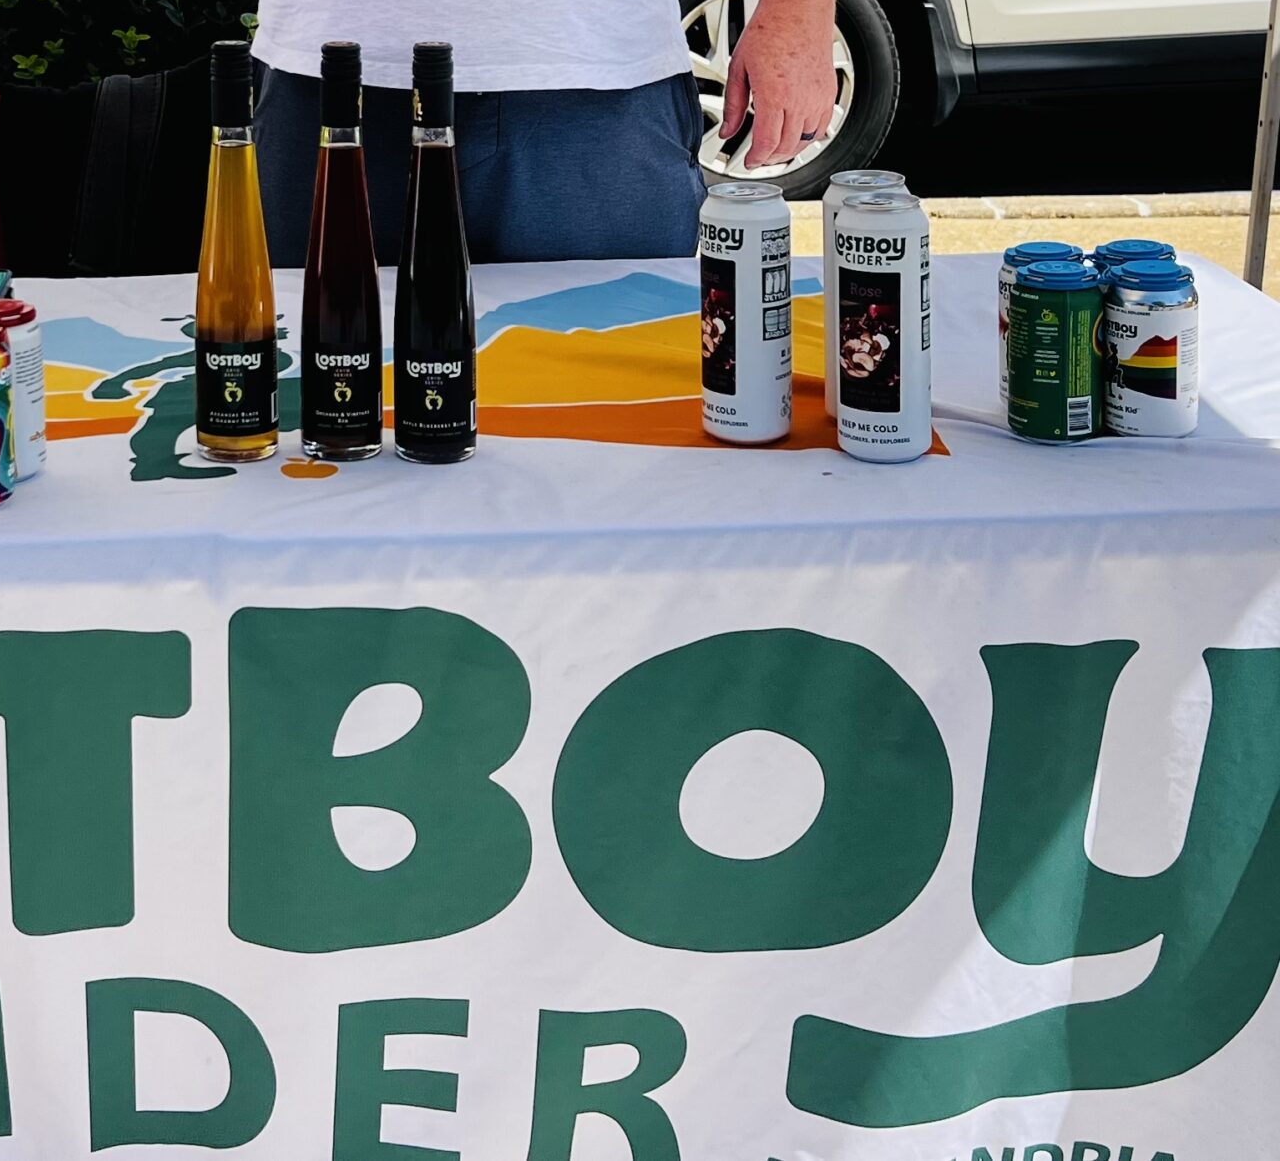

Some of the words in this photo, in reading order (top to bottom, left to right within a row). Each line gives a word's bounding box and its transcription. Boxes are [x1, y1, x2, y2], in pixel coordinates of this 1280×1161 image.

[845, 253, 882, 266] CIDER
[850, 282, 882, 297] Rose
[715, 405, 736, 415] COLD
[858, 423, 871, 432] ME
[873, 425, 898, 433] COLD
